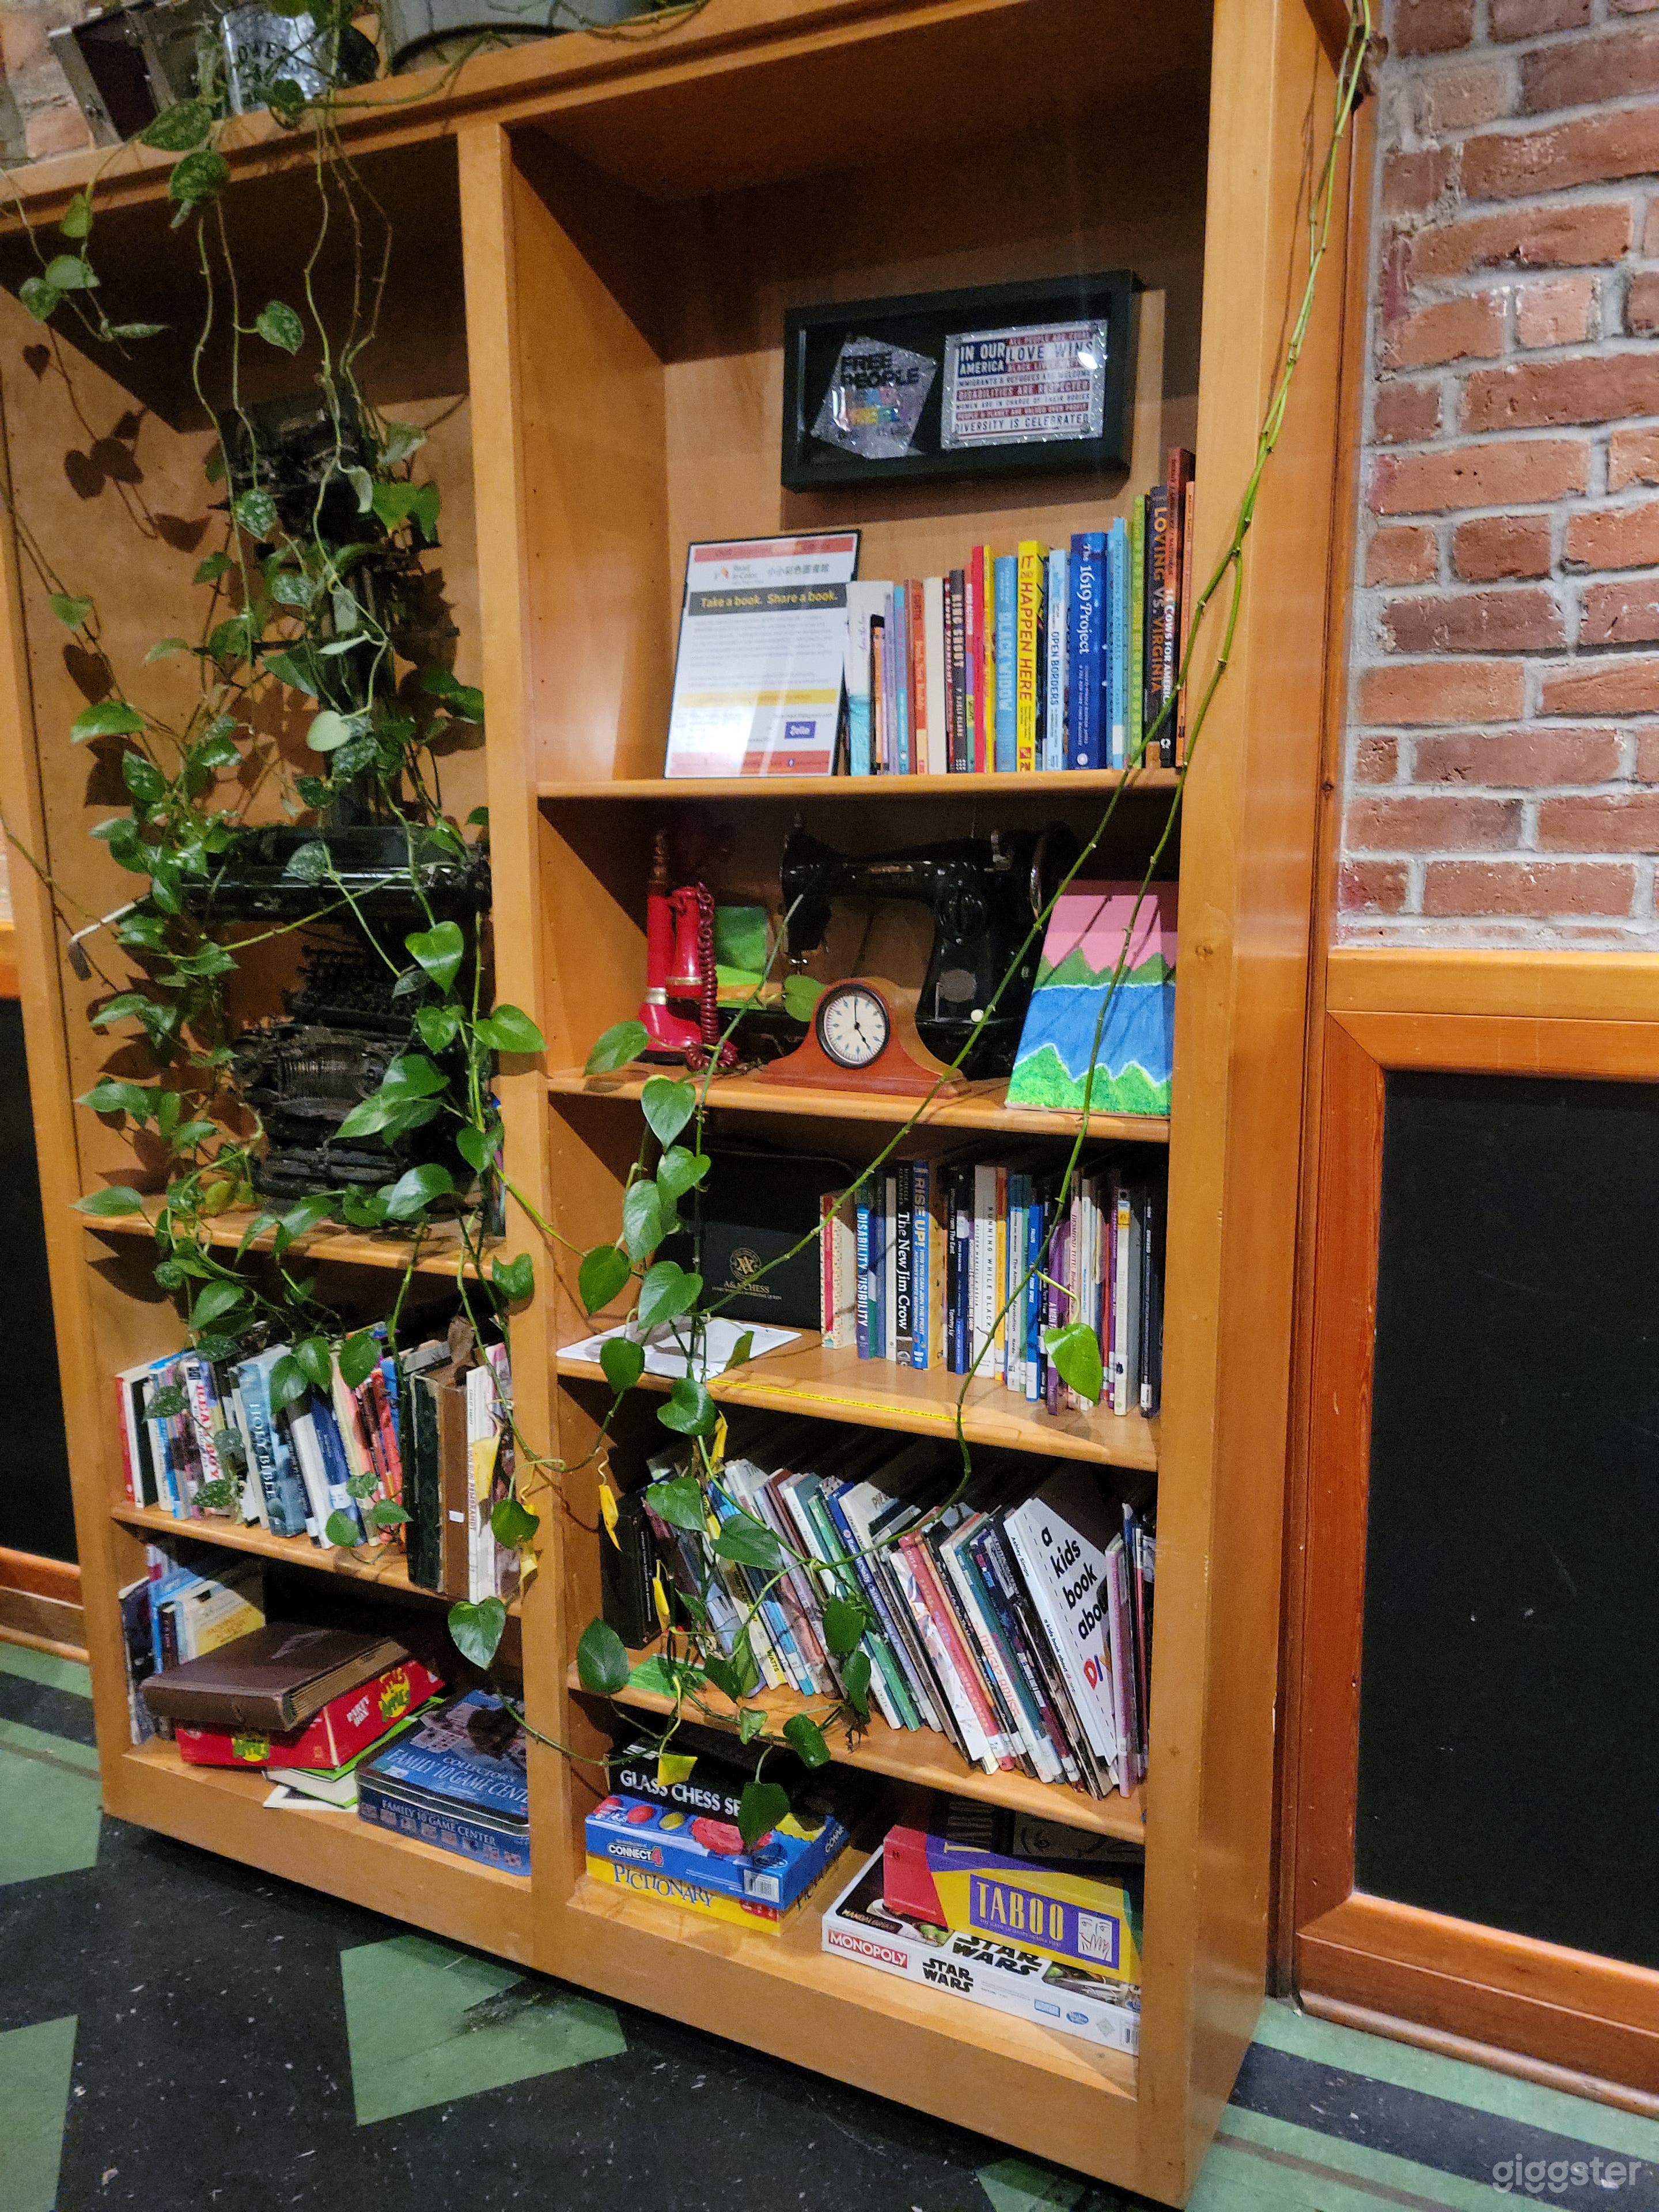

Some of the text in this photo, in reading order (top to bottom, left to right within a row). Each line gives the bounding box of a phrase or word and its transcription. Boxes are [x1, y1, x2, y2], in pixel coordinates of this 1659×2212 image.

[959, 342, 1006, 361] IN OUR
[960, 359, 1005, 374] AMERICA
[1009, 346, 1044, 362] LOVE
[955, 414, 1089, 433] DIVERSITY IS CELEBRATED
[701, 597, 724, 608] Take
[726, 599, 733, 607] a
[767, 593, 798, 604] Share
[800, 594, 806, 603] a
[808, 591, 838, 602] book.
[1077, 544, 1095, 655] The 1619 Project
[1151, 506, 1168, 692] LOVING VS. VIRGINIA
[1165, 589, 1173, 602] 14
[998, 612, 1012, 657] BLACK
[1020, 582, 1033, 653] HAPPEN
[1051, 631, 1059, 657] OPEN
[1164, 641, 1173, 662] FOR
[998, 661, 1012, 712] WIDOW
[1019, 658, 1032, 702] HERE
[1050, 660, 1059, 705] BORDERS
[1162, 664, 1172, 709] AMERIC
[914, 1178, 926, 1248] RISE UP!
[857, 1213, 868, 1327] DISABILITY VISIBILITY
[896, 1211, 911, 1330] The New Jim Crow
[251, 1403, 276, 1498] HOLY BIBLE
[1009, 1536, 1023, 1556] Ashley
[1041, 1526, 1053, 1547] a
[1050, 1539, 1081, 1579] kids
[1062, 1562, 1099, 1611] book
[1077, 1601, 1109, 1641] abou
[766, 1649, 779, 1672] WATTS
[1046, 1623, 1055, 1637] kids
[1051, 1637, 1061, 1653] book
[1057, 1653, 1069, 1672] about
[386, 1749, 435, 1774] FAMILY
[449, 1770, 491, 1790] GAME
[488, 1782, 528, 1803] CENTE
[620, 1770, 669, 1797] GLASS
[671, 1785, 721, 1812] CHESS
[382, 1798, 416, 1817] FAMILY
[429, 1815, 456, 1834] GAME
[457, 1824, 496, 1847] CENTER
[608, 1843, 664, 1866] CONNECT 4
[612, 1862, 717, 1908] PICTIONARY
[976, 1881, 1065, 1942] TABOO
[828, 1931, 908, 1967] MONOPOLY
[922, 1957, 974, 1982] STAR
[952, 1942, 1040, 1976] WARS
[956, 1934, 1043, 1968] STAR
[922, 1968, 974, 1993] WARS
